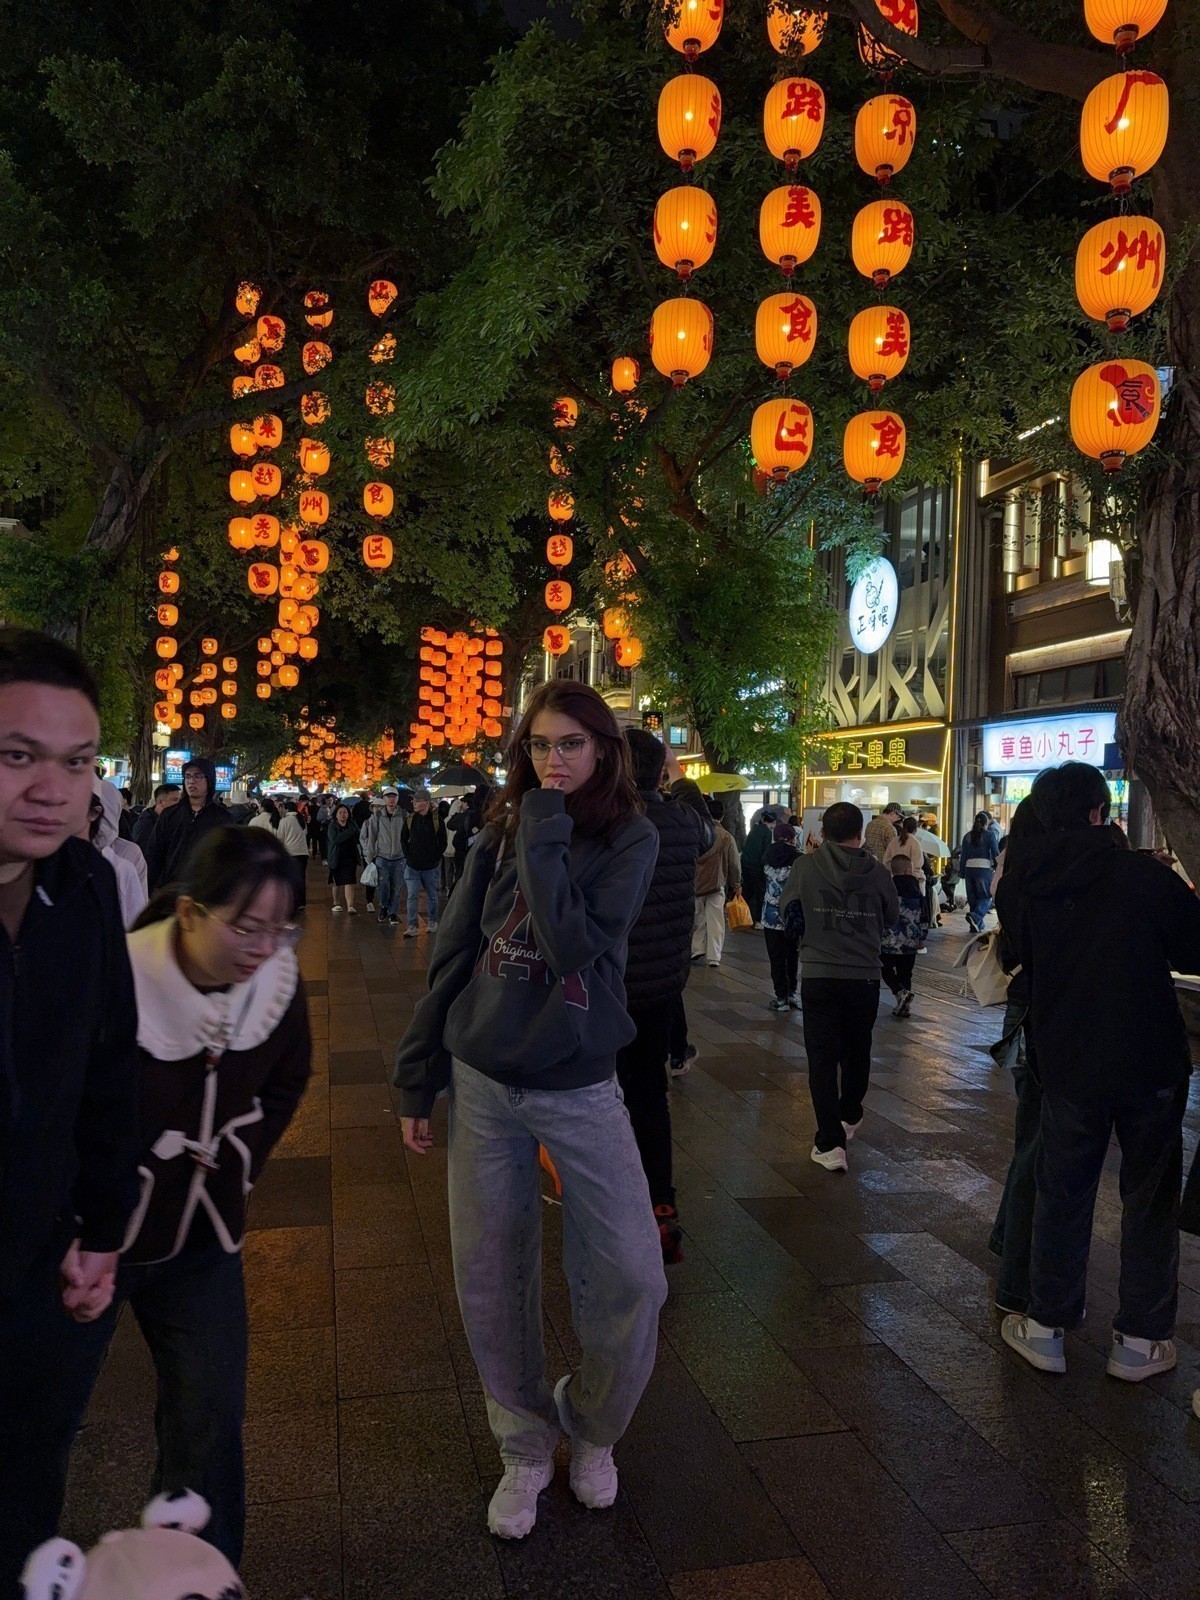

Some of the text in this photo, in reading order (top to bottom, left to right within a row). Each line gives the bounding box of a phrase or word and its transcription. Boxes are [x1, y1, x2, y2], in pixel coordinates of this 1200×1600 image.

[781, 82, 822, 122] 路
[884, 98, 914, 145] 京
[780, 185, 815, 229] 美
[878, 208, 913, 247] 路
[1099, 229, 1162, 289] 州
[779, 297, 813, 343] 食
[876, 311, 908, 358] 美
[774, 404, 810, 455] 区
[871, 415, 903, 458] 食
[301, 496, 323, 516] 州
[367, 484, 384, 504] 食
[367, 537, 387, 560] 区
[1001, 728, 1095, 760] 章鱼小丸子
